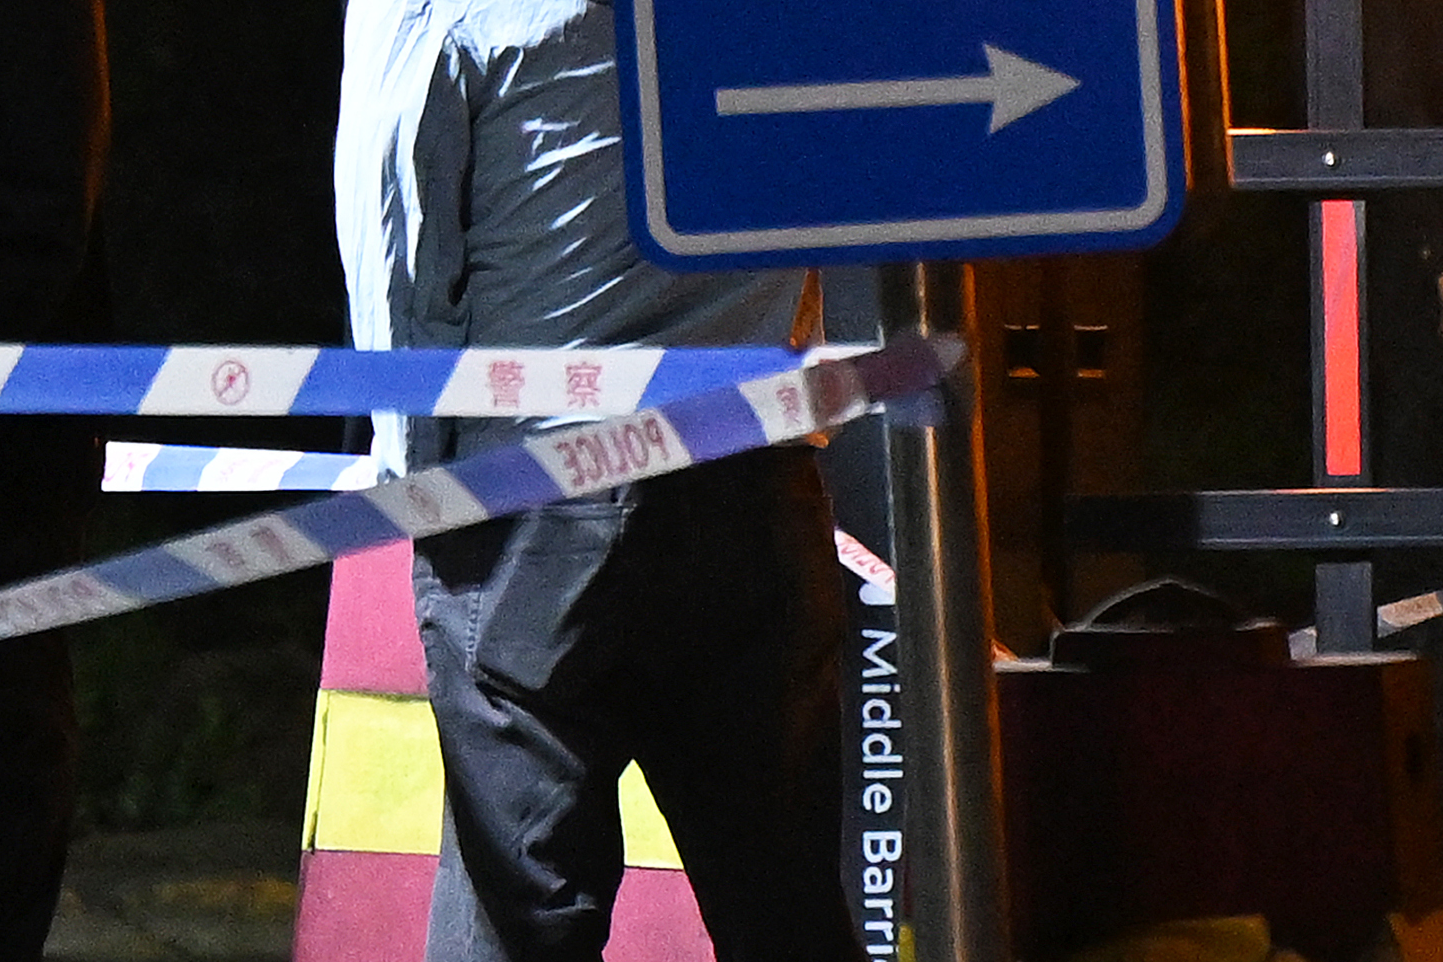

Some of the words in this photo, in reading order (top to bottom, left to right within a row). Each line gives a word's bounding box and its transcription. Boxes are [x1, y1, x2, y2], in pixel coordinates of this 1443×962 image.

[488, 360, 603, 408] 警察
[862, 629, 904, 814] Middle
[862, 831, 903, 962] Barri
